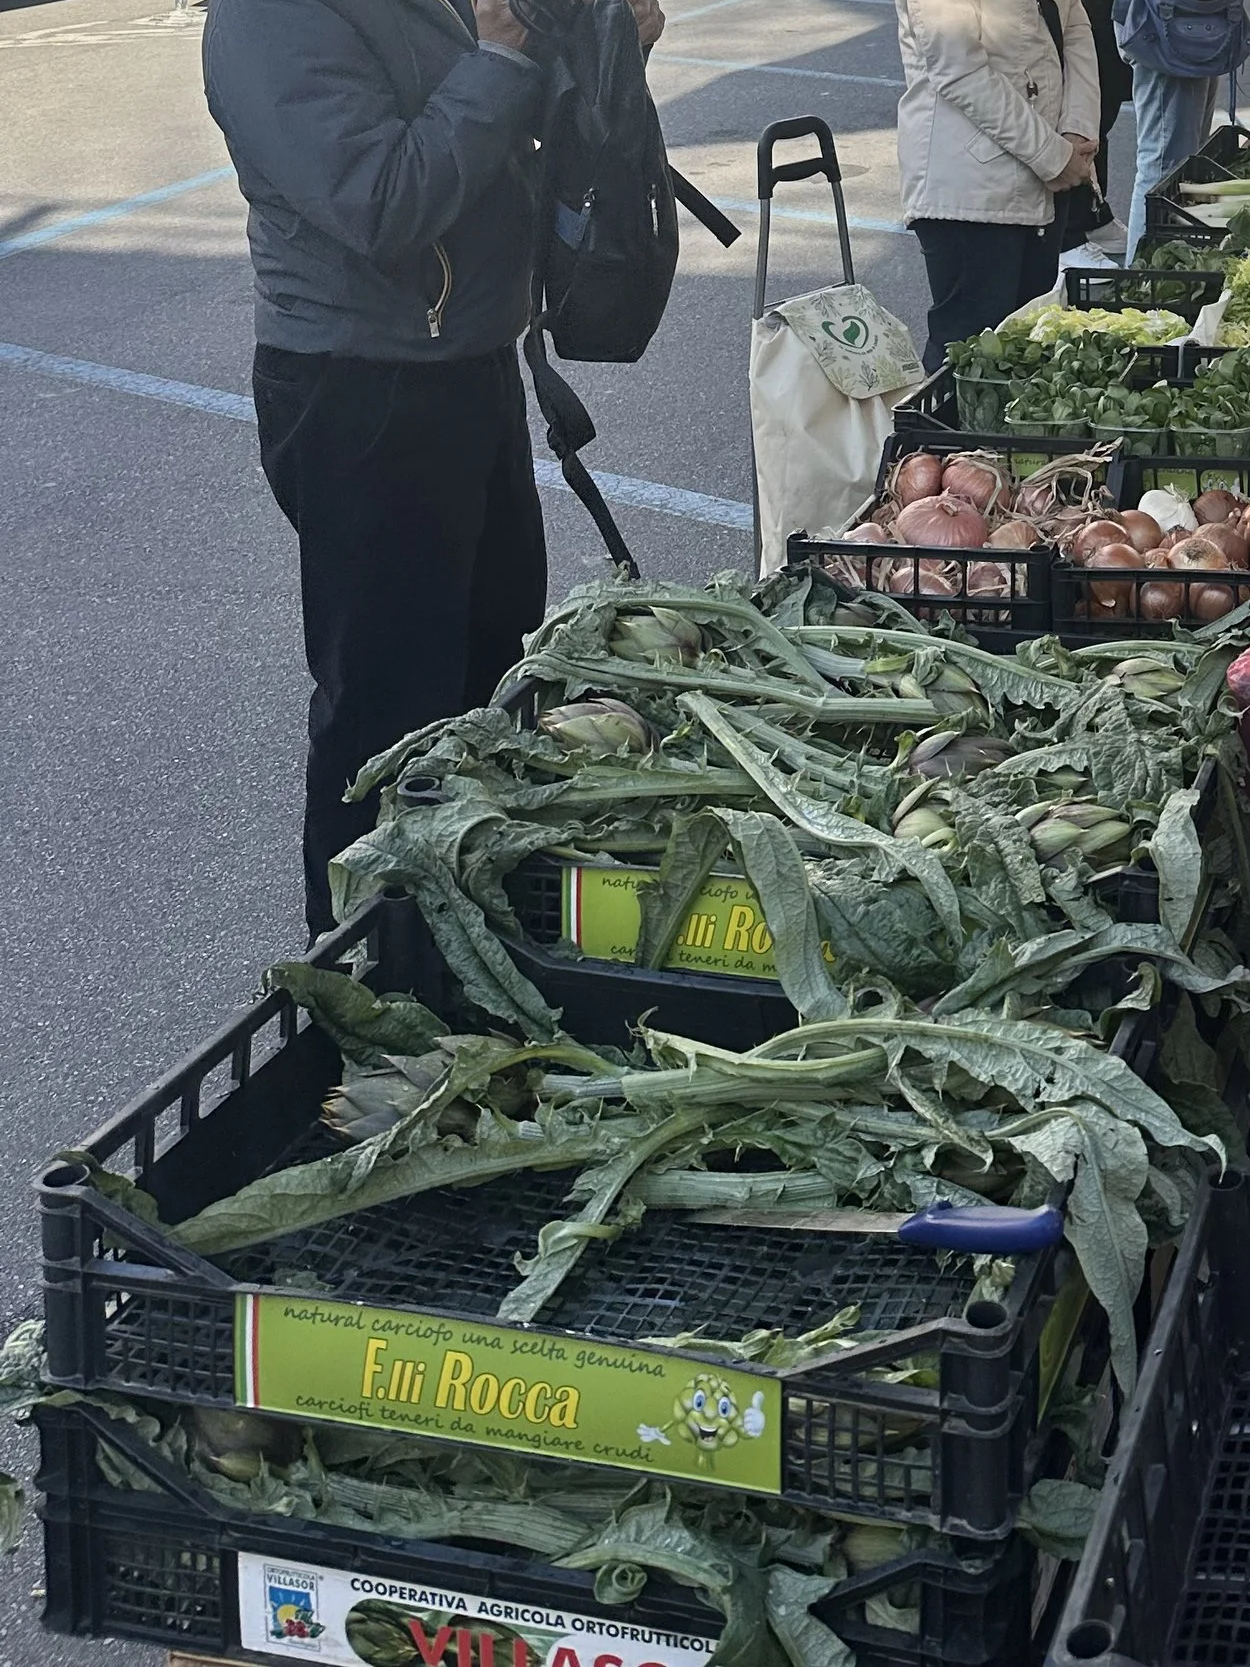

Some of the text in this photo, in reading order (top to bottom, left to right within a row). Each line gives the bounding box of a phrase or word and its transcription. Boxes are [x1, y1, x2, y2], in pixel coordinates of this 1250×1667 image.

[679, 950, 729, 968] teneri
[735, 955, 755, 972] da
[284, 1306, 666, 1378] natural carciofo una scelta genuina
[361, 1336, 581, 1429] F.lli Rocca
[296, 1394, 654, 1463] carciofi teneri da mangiare crudi
[266, 1573, 315, 1592] VILLASOR
[350, 1577, 717, 1655] COOPERATIVA AGRICOLA ORTOFRUTTICOL
